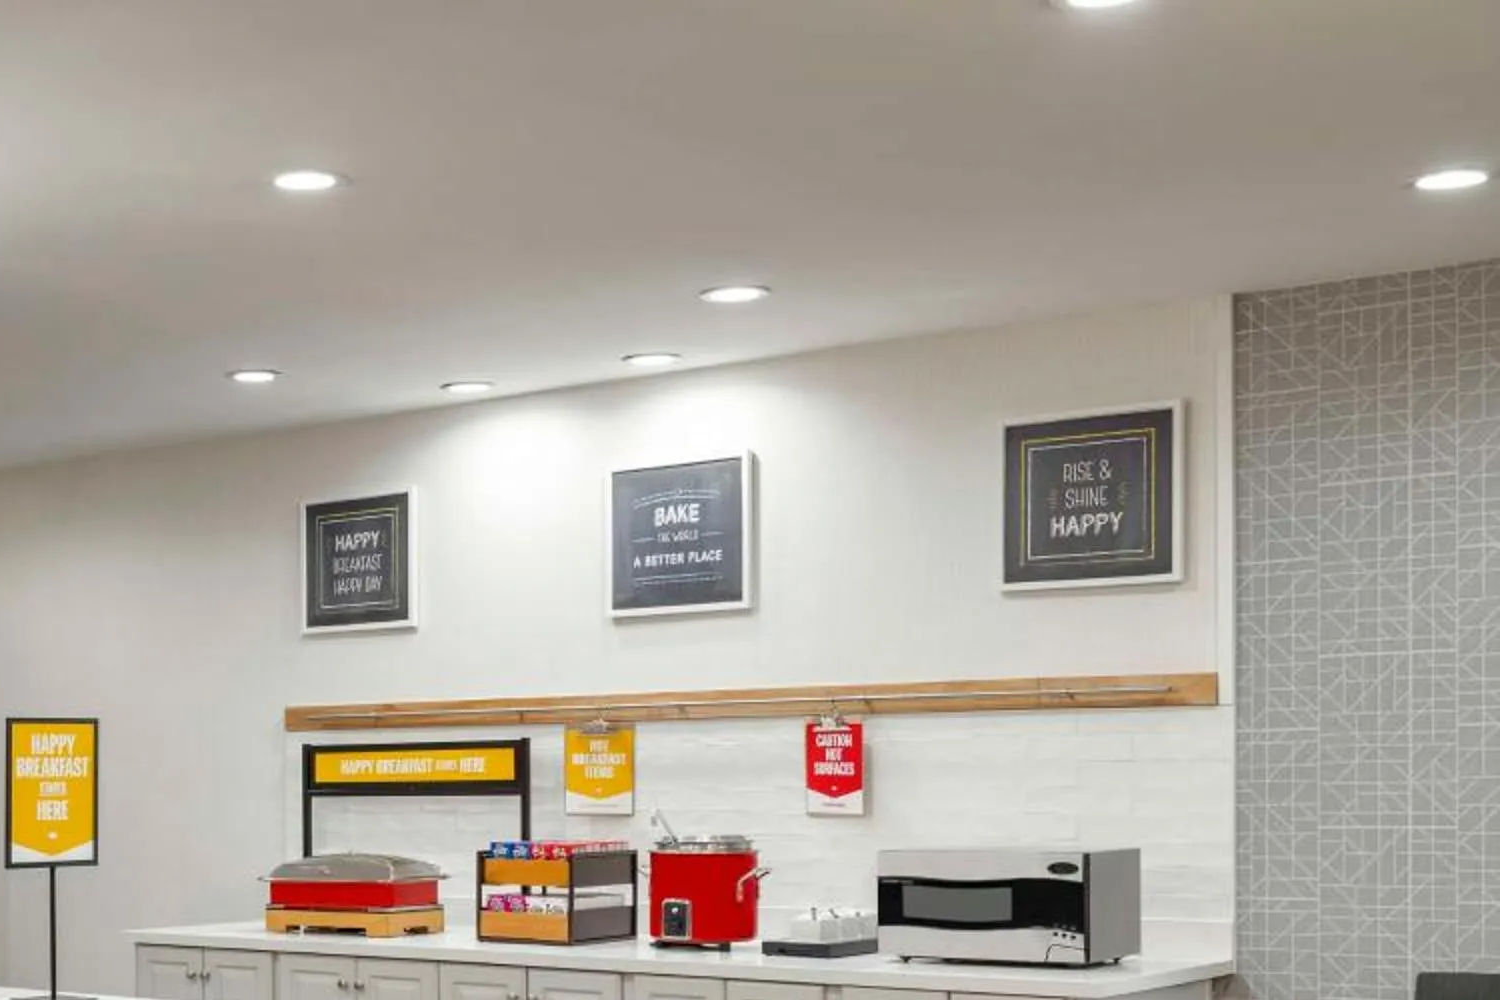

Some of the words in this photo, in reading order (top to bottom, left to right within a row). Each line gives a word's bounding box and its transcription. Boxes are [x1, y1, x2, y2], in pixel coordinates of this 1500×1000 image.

[1063, 461, 1095, 483] RISE
[1100, 458, 1113, 481] &
[1064, 485, 1109, 509] SHINE
[654, 503, 700, 527] BAKE
[1050, 511, 1124, 538] HAPPY
[334, 530, 380, 553] HAPPY
[633, 556, 642, 569] A
[645, 552, 685, 567] BETTER
[688, 549, 723, 564] PLACE
[30, 733, 76, 755] HAPPY
[16, 756, 89, 777] BREAKFAST
[36, 800, 69, 821] HERE
